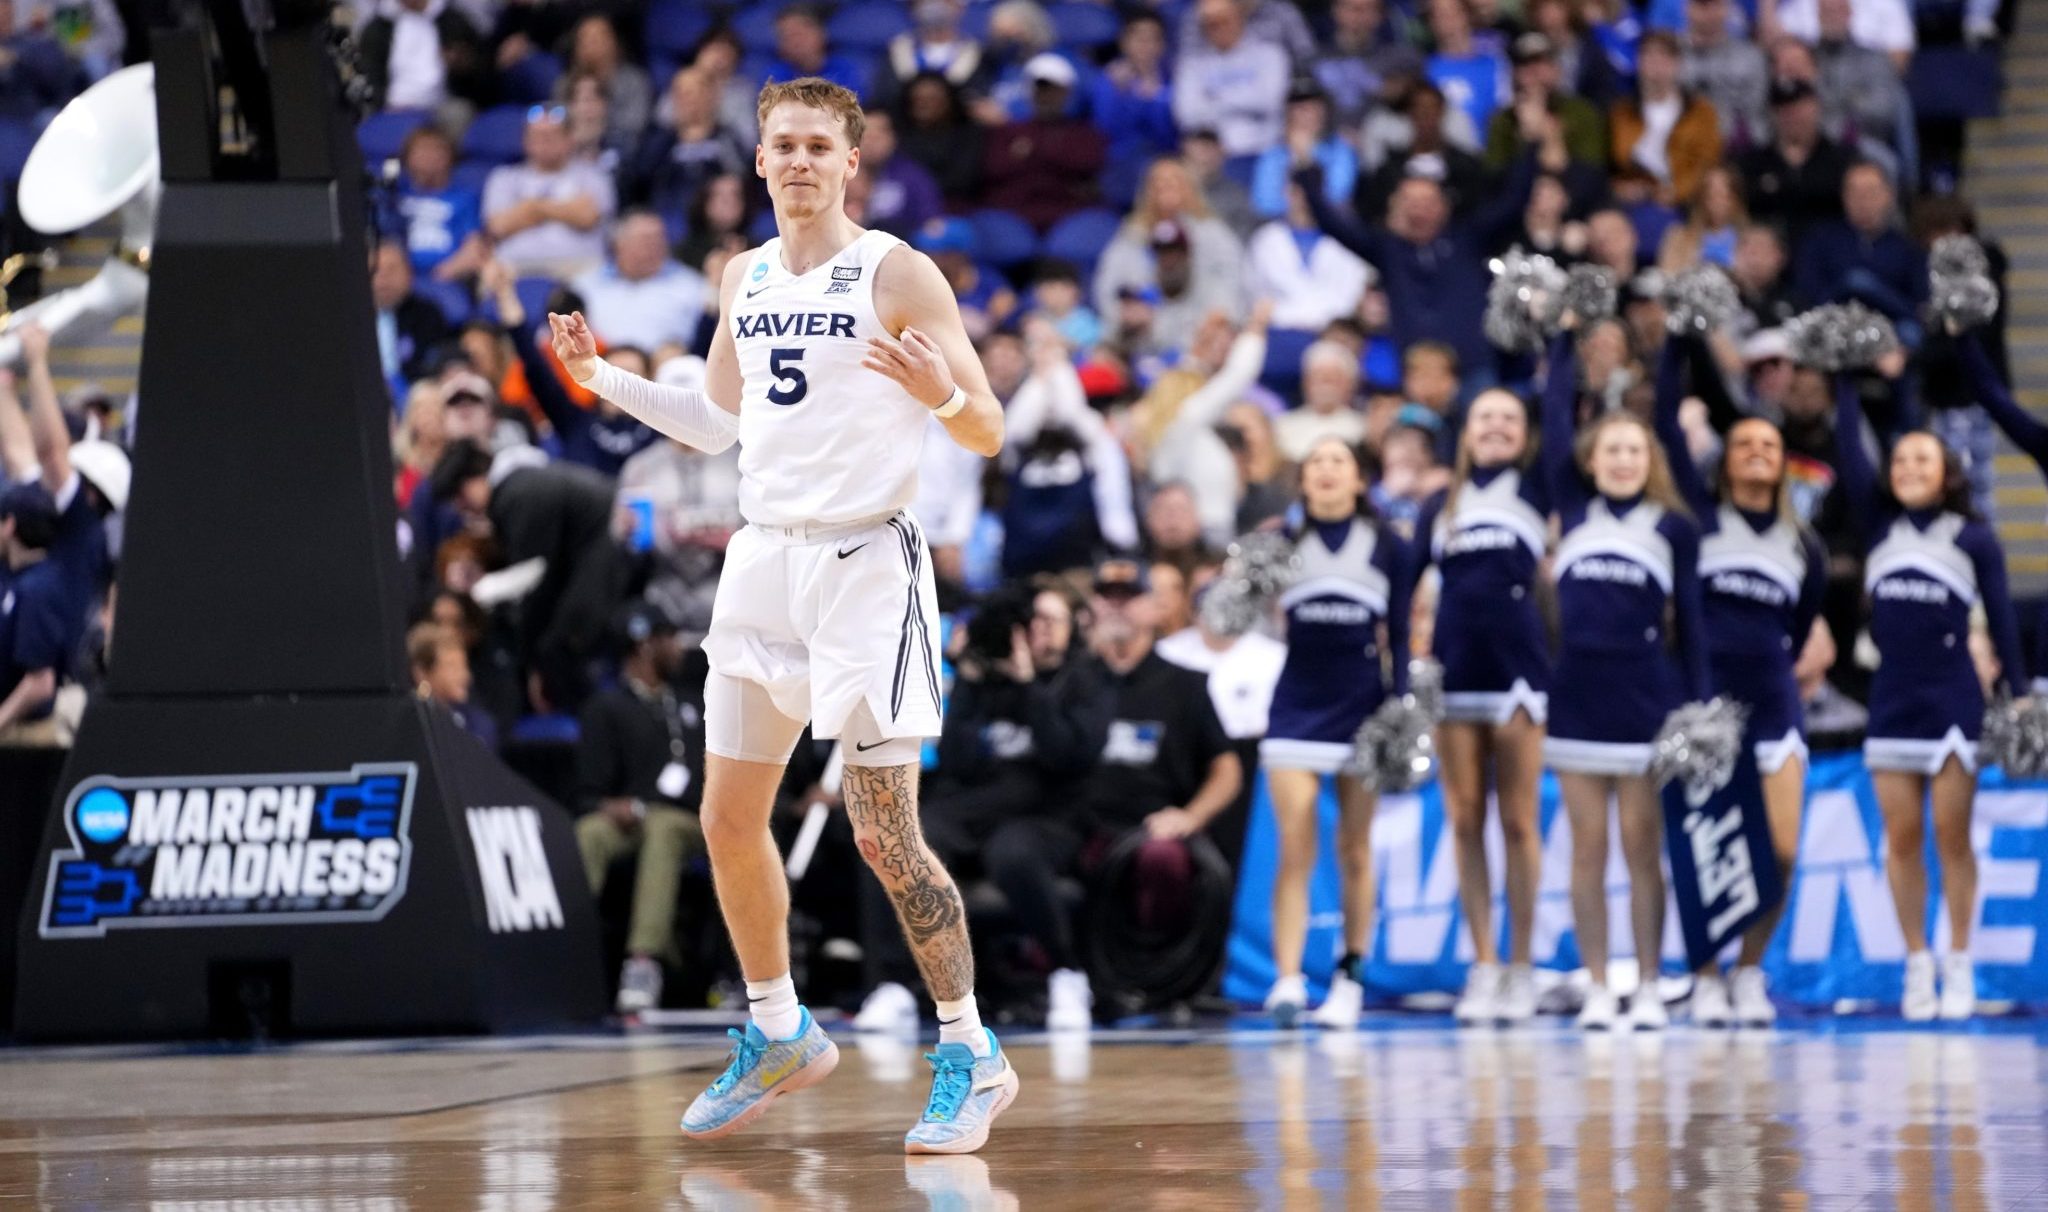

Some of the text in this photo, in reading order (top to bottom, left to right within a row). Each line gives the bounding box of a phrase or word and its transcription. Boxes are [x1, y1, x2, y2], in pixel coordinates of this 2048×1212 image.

[736, 313, 857, 338] XAVIER
[765, 348, 808, 406] 5
[127, 784, 316, 846] MARCH
[150, 837, 402, 901] MADNESS
[464, 805, 565, 934] NCAA
